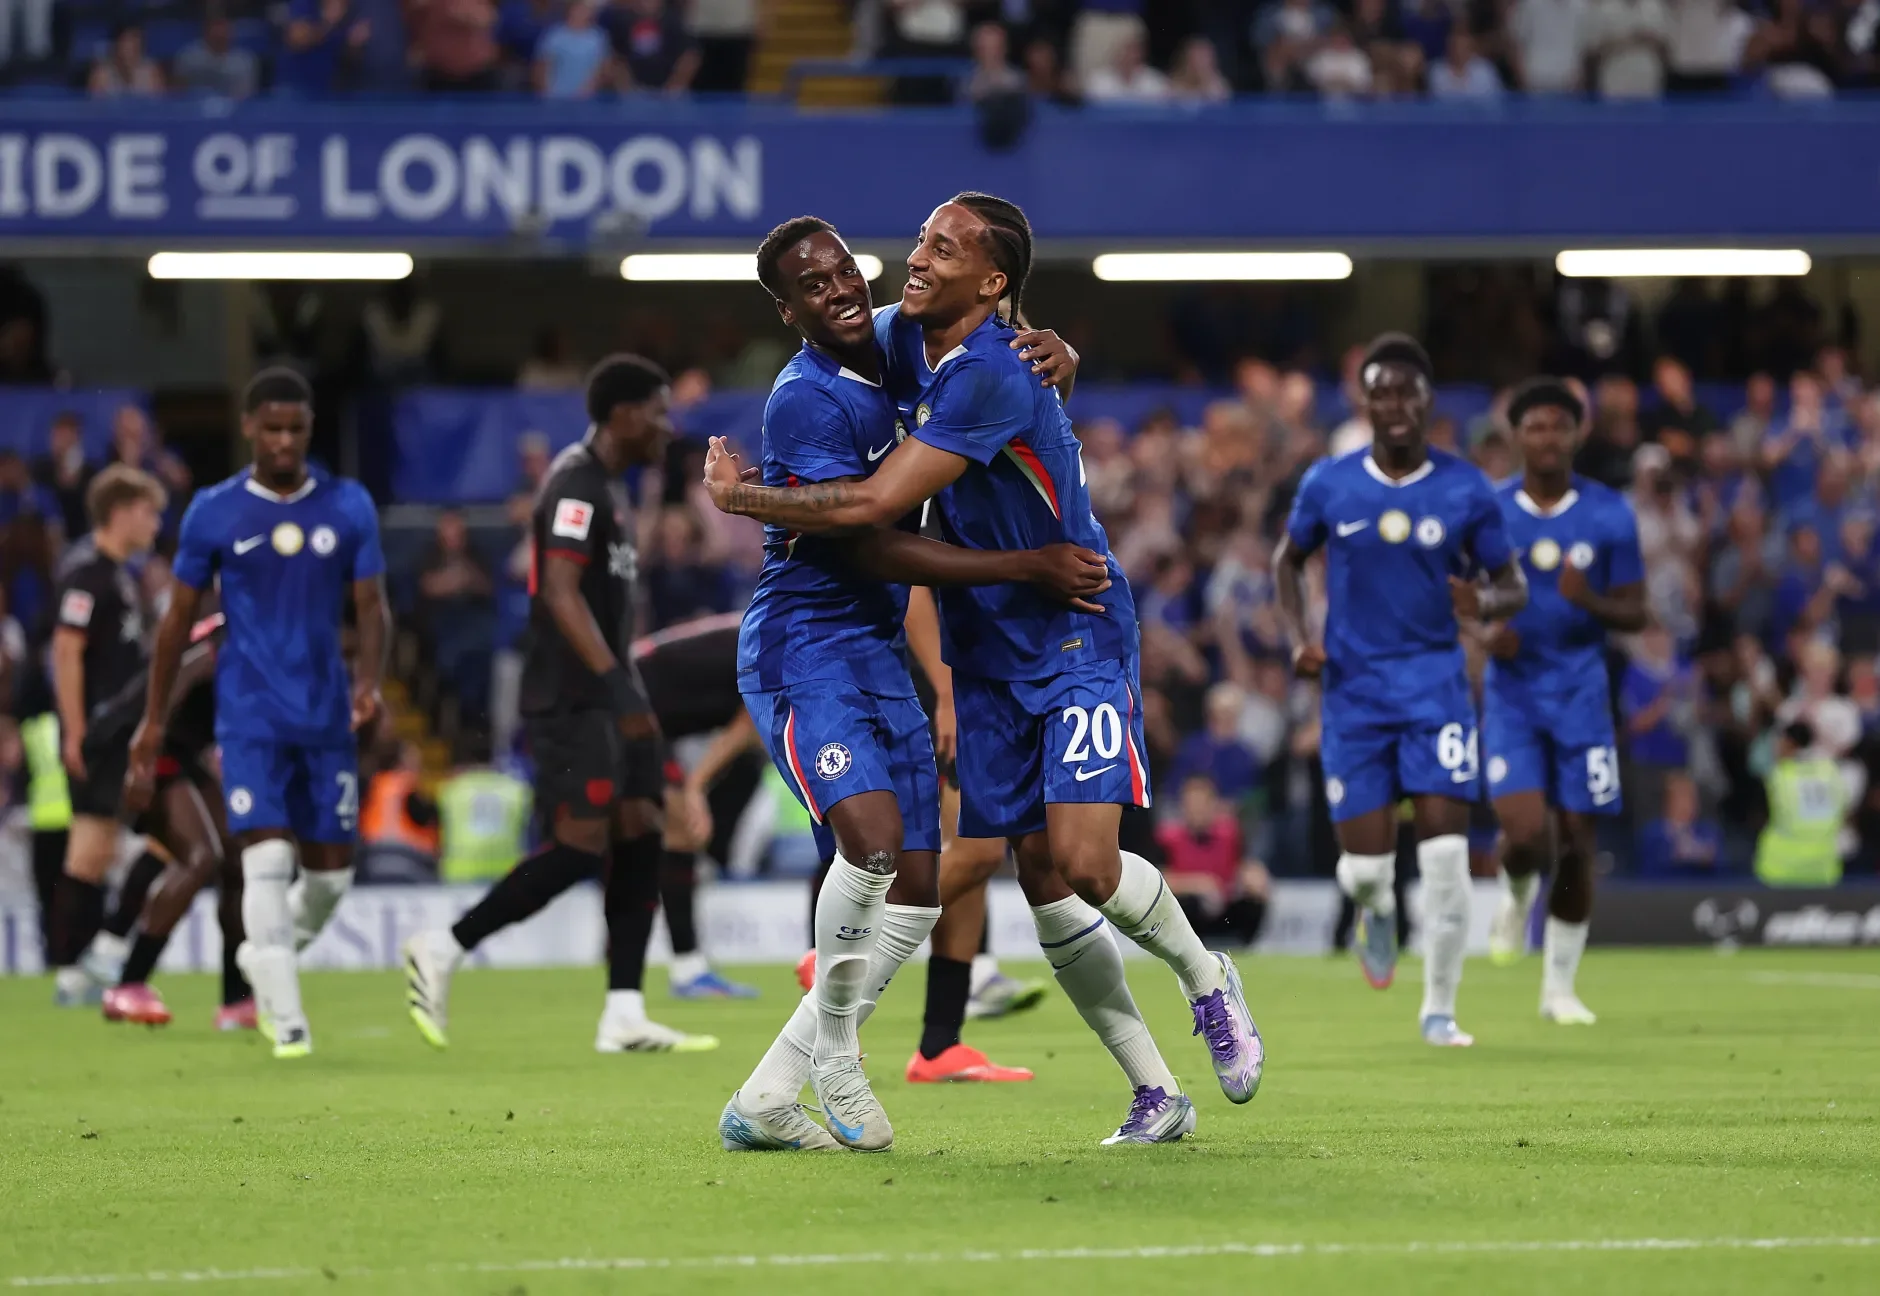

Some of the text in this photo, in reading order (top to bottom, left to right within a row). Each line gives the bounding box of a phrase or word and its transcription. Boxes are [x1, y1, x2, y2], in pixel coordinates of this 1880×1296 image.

[0, 133, 763, 219] IDE OF LONDON
[1062, 702, 1122, 763] 20
[840, 925, 872, 935] CFC
